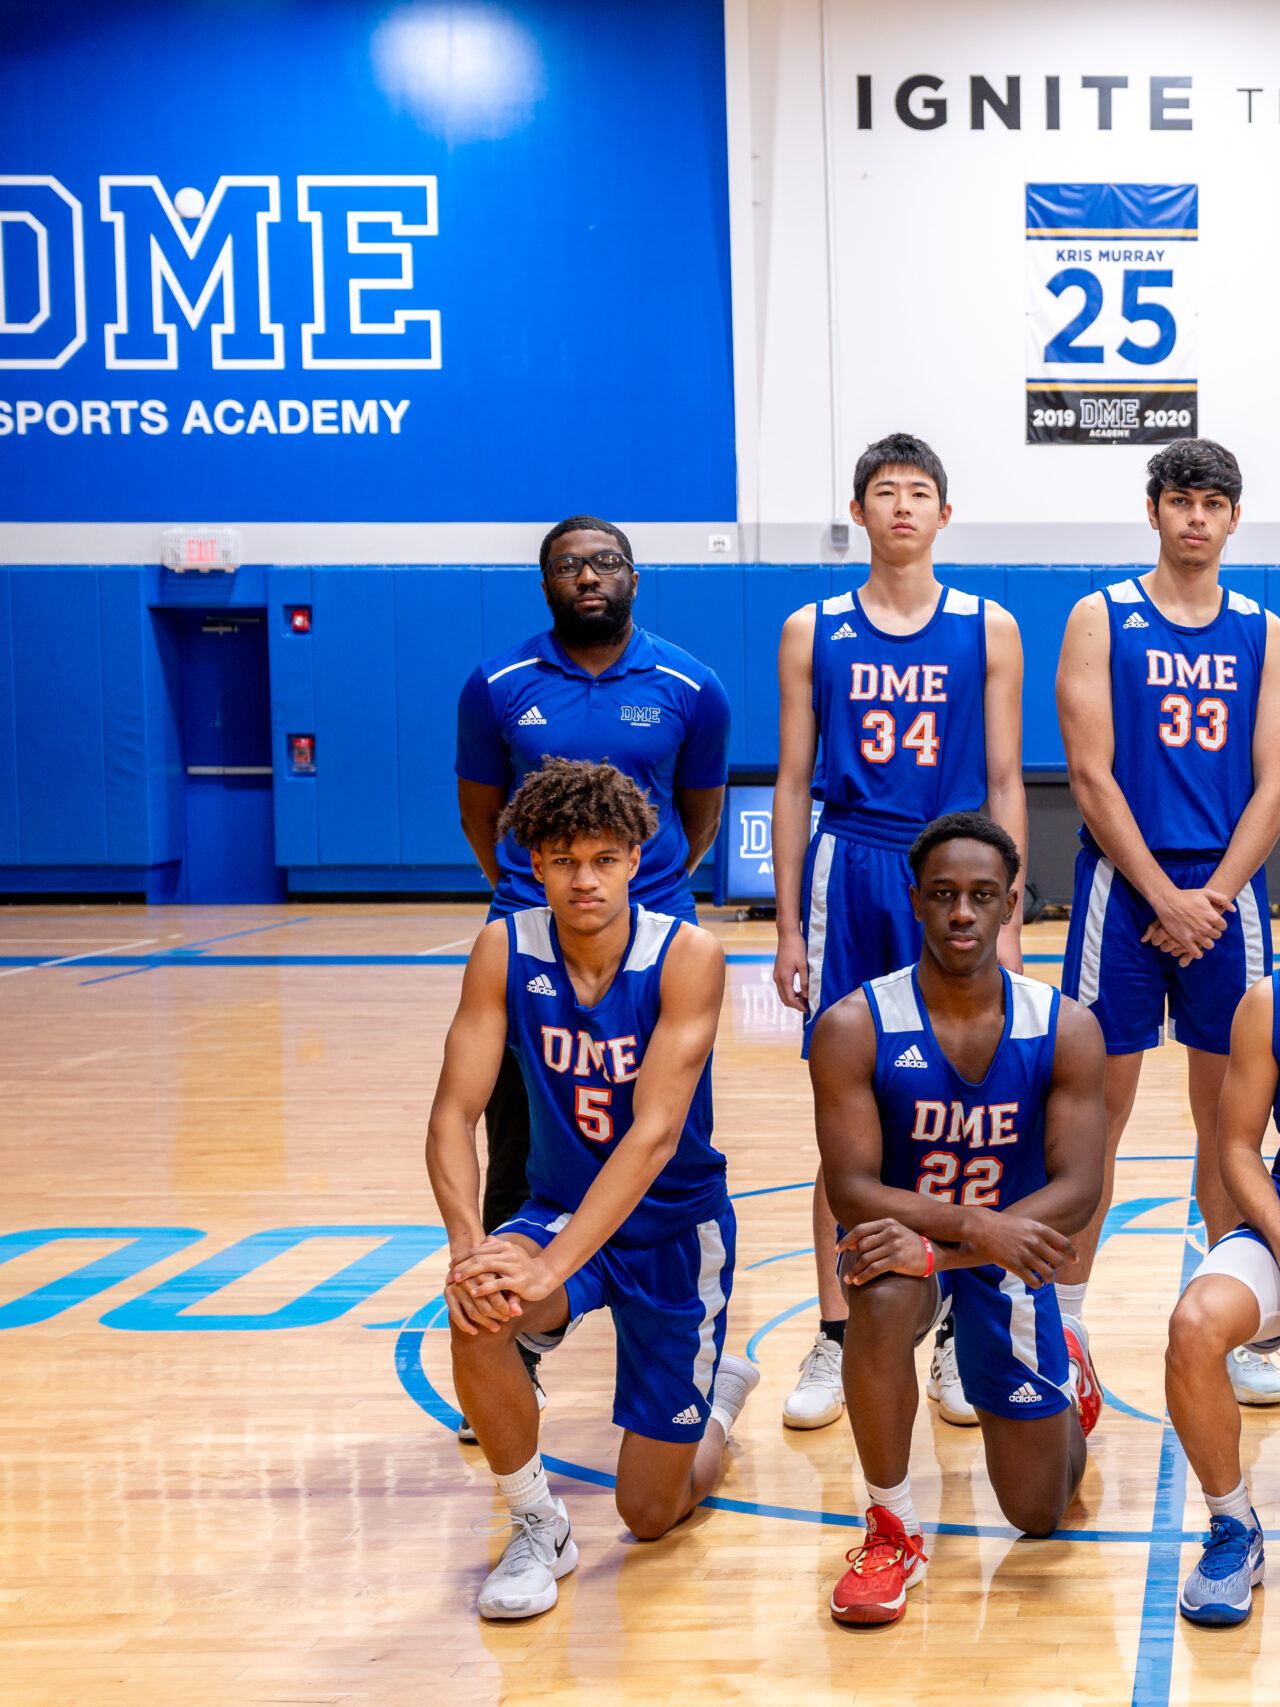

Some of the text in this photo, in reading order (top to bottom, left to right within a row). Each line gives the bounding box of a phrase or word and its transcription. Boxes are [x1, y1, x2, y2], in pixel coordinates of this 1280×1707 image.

[856, 73, 1194, 131] IGNITE
[1056, 249, 1165, 263] KRIS MURRAY
[0, 174, 443, 370] DME
[1044, 267, 1177, 365] 25
[181, 400, 410, 435] ACADEMY
[1032, 398, 1192, 429] 2019 DME 2020
[1088, 429, 1130, 438] ACADEMY
[186, 539, 217, 563] EXIT
[830, 632, 857, 641] adidas
[1124, 621, 1149, 630] adidas
[849, 663, 948, 702] DME
[1146, 649, 1238, 691] DME
[517, 718, 547, 726] adidas
[620, 705, 661, 723] DME
[1159, 693, 1228, 752] 33
[861, 709, 940, 766] 34
[526, 984, 557, 997] adidas
[894, 1059, 928, 1069] adidas
[574, 1085, 613, 1143] 5
[911, 1100, 1018, 1149] DME
[915, 1150, 1003, 1207] 22
[1008, 1394, 1043, 1403] adidas
[672, 1416, 702, 1425] adidas
